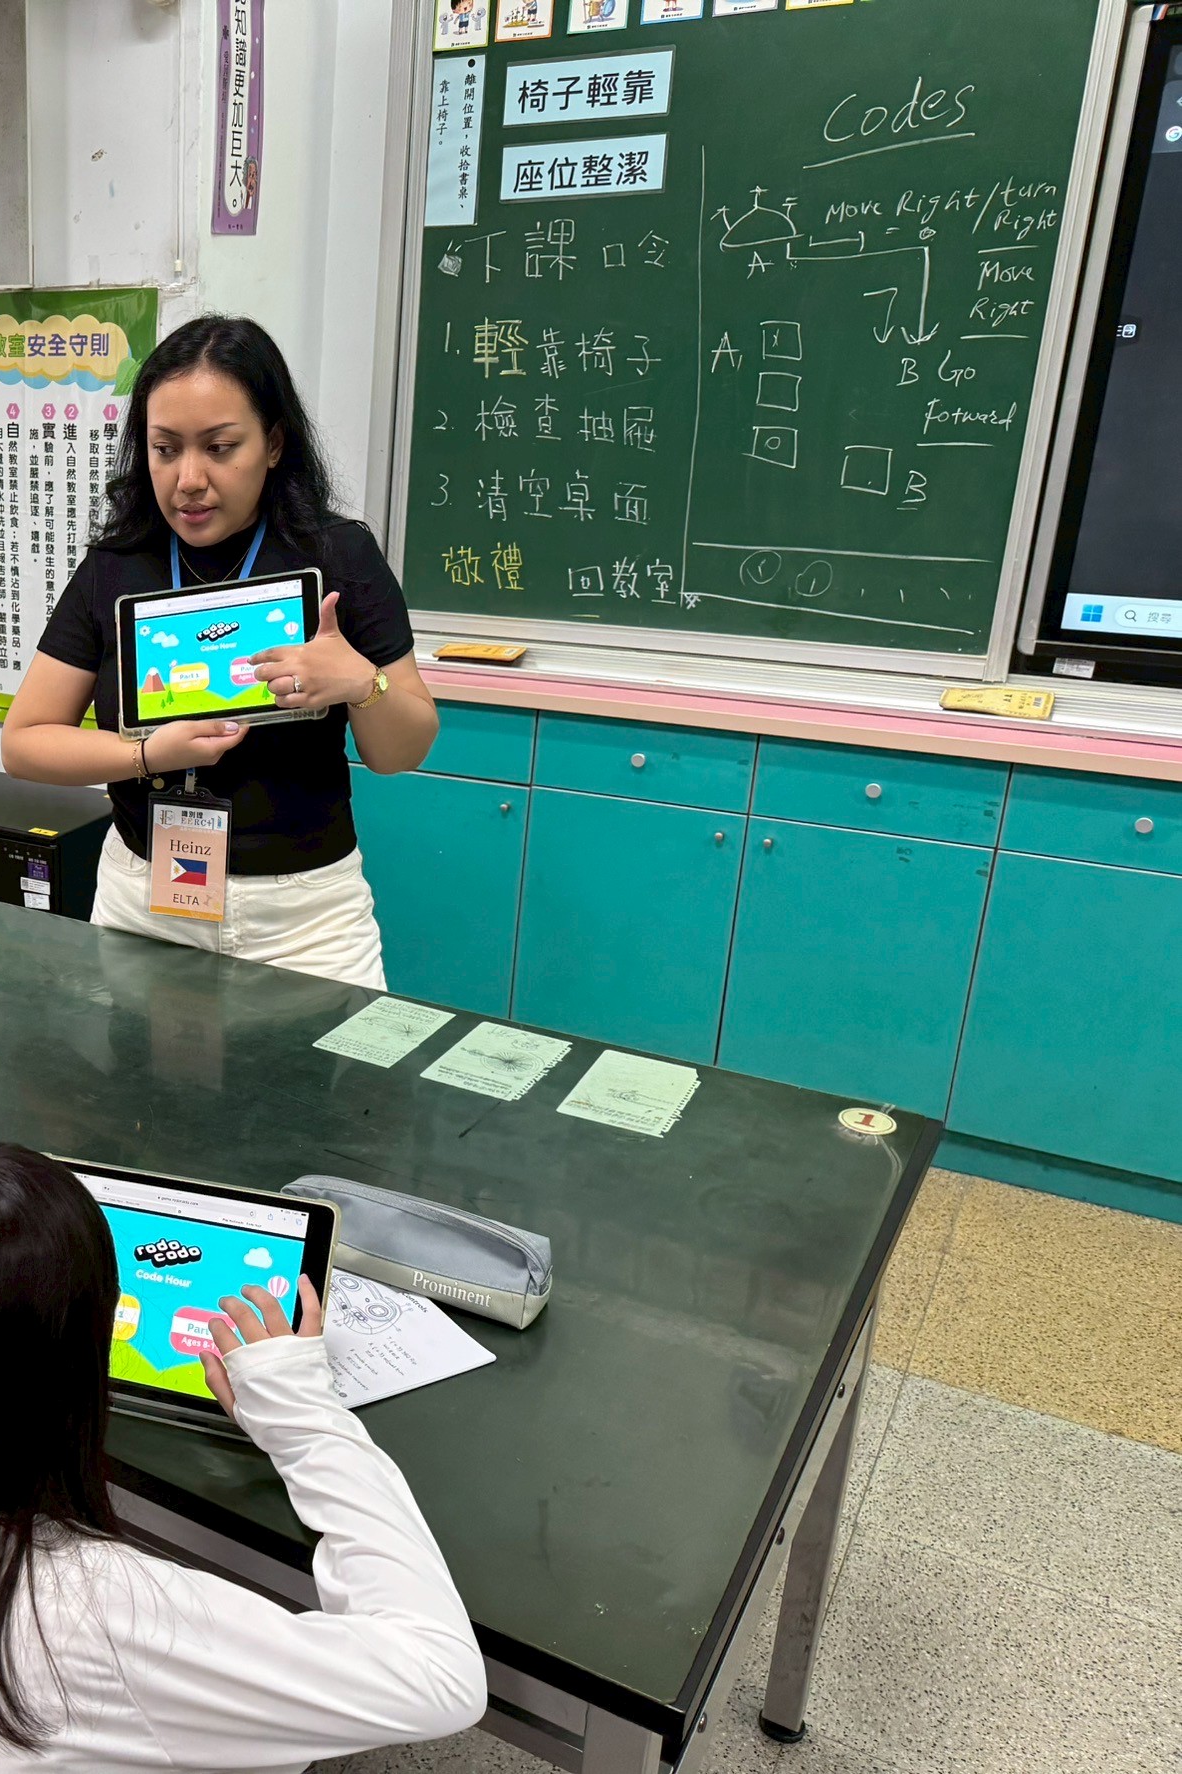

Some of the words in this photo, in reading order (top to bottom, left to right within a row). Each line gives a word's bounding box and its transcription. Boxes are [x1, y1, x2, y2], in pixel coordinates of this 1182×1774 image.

[517, 69, 656, 114] 椅子輕靠
[436, 79, 451, 147] 靠上椅子。
[823, 76, 975, 143] Codes
[513, 151, 649, 194] 座位整潔
[825, 200, 883, 225] Move
[994, 210, 1058, 242] Right
[977, 261, 1035, 291] Move
[969, 298, 1035, 328] Right
[473, 317, 662, 379] 輕靠椅子
[896, 357, 919, 386] B
[938, 350, 977, 387] Go
[474, 394, 656, 452] 檢查抽屜
[477, 469, 651, 525] 清空桌面
[903, 470, 928, 504] B
[442, 542, 525, 591] 敬禮
[568, 556, 676, 604] 回教室
[197, 621, 225, 639] rodo
[209, 621, 239, 639] codo
[170, 839, 212, 856] Heinz
[172, 893, 200, 906] ELTA
[854, 1112, 875, 1128] 1
[136, 1239, 180, 1256] rodo
[153, 1246, 201, 1262] codo
[136, 1269, 164, 1283] Code
[165, 1274, 192, 1288] Hour
[411, 1270, 492, 1308] Prominent
[181, 1336, 201, 1347] Ages
[187, 1322, 209, 1336] Part
